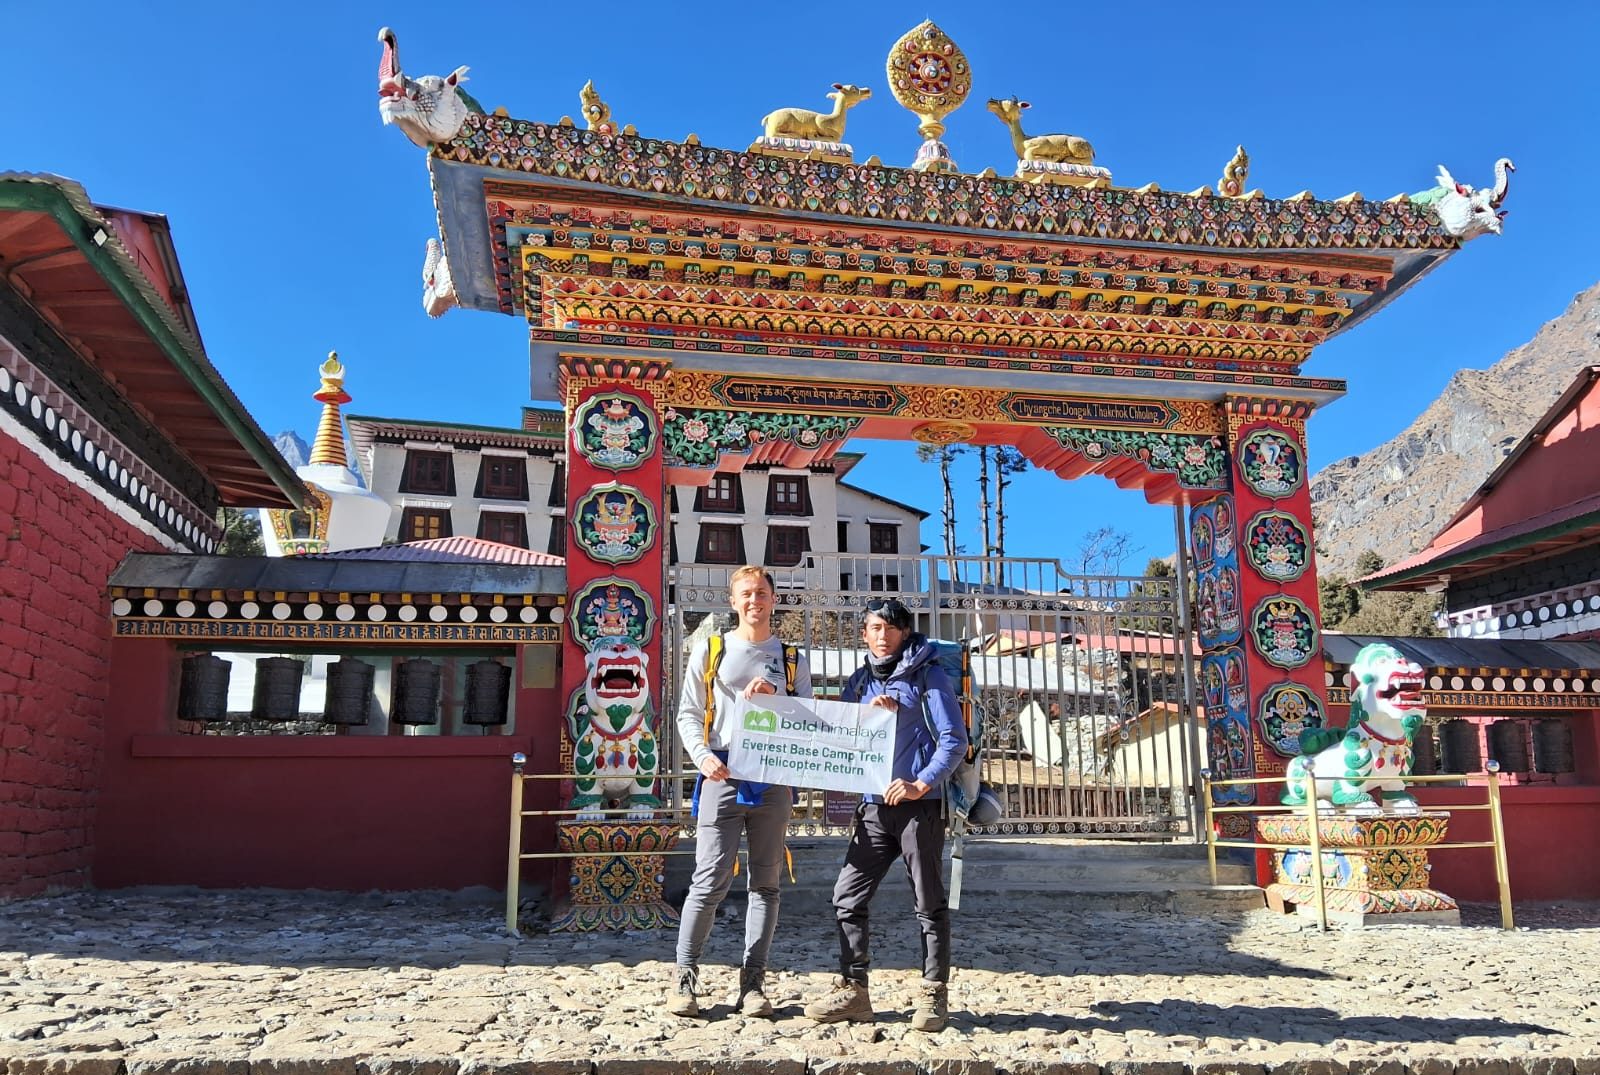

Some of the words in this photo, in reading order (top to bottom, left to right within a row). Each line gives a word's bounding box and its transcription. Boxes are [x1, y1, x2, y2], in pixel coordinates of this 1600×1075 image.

[781, 717, 818, 733] bold
[820, 721, 887, 743] himalaya
[742, 738, 787, 754] Everest
[790, 743, 819, 757] Base
[821, 747, 854, 761] Camp
[859, 751, 884, 763] Trek
[760, 755, 821, 771] Helicopter
[824, 762, 864, 776] Return
